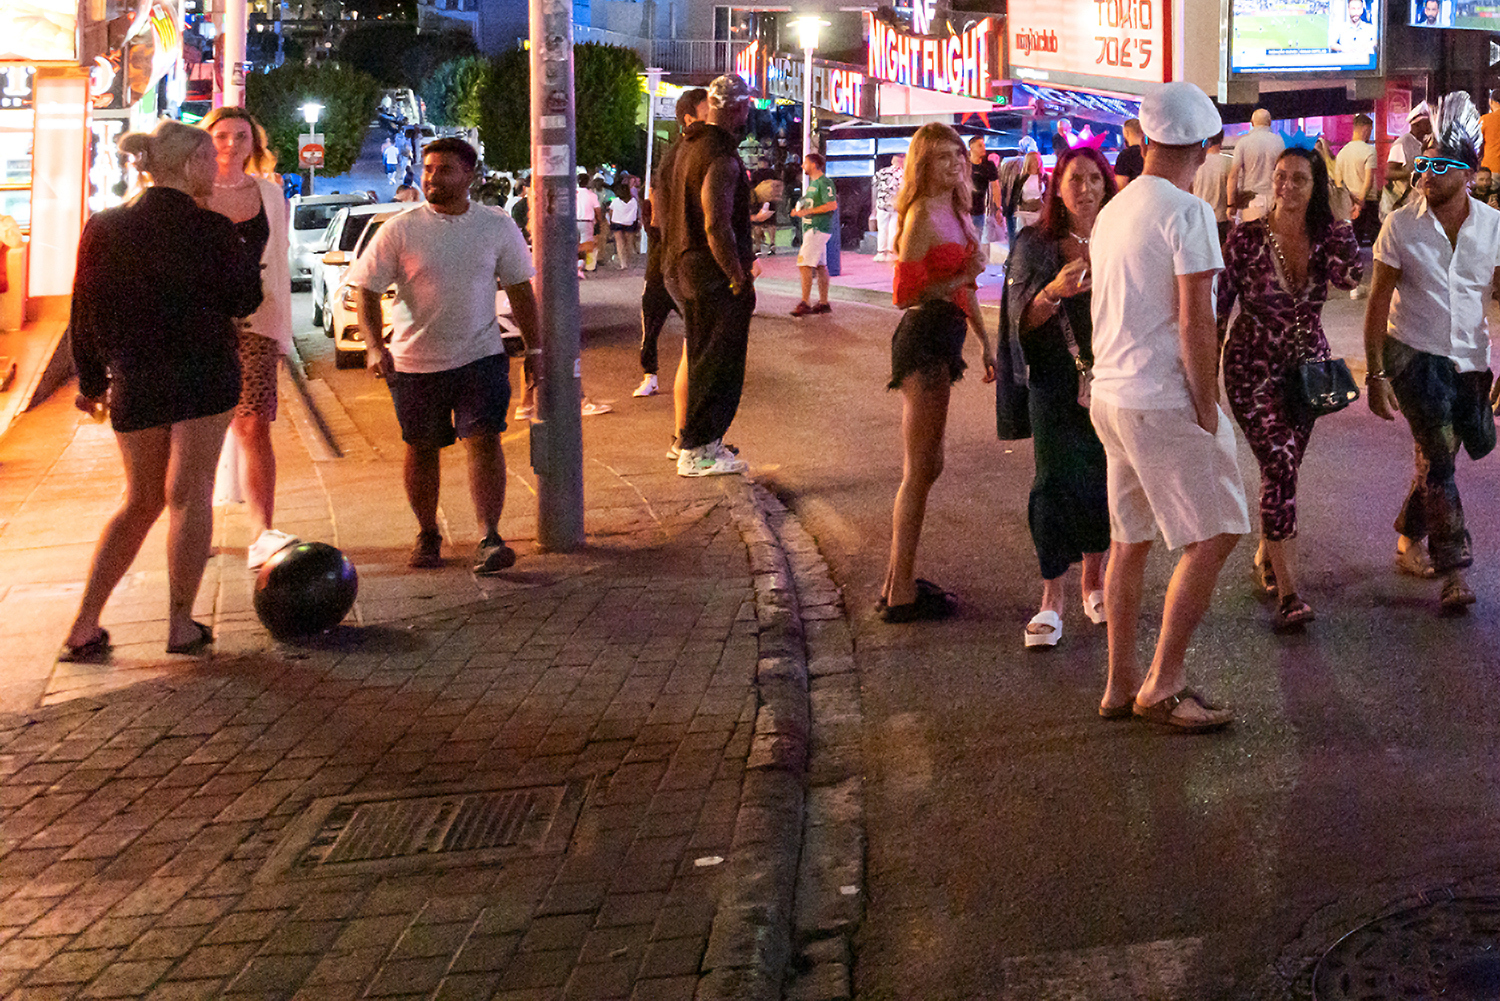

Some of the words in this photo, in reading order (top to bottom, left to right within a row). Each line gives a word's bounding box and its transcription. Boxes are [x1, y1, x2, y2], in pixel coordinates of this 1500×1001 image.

[868, 11, 921, 86] NIGHT
[923, 17, 993, 98] FLIGHT
[1016, 28, 1058, 56] nightclub
[1094, 36, 1152, 69] JOE'S
